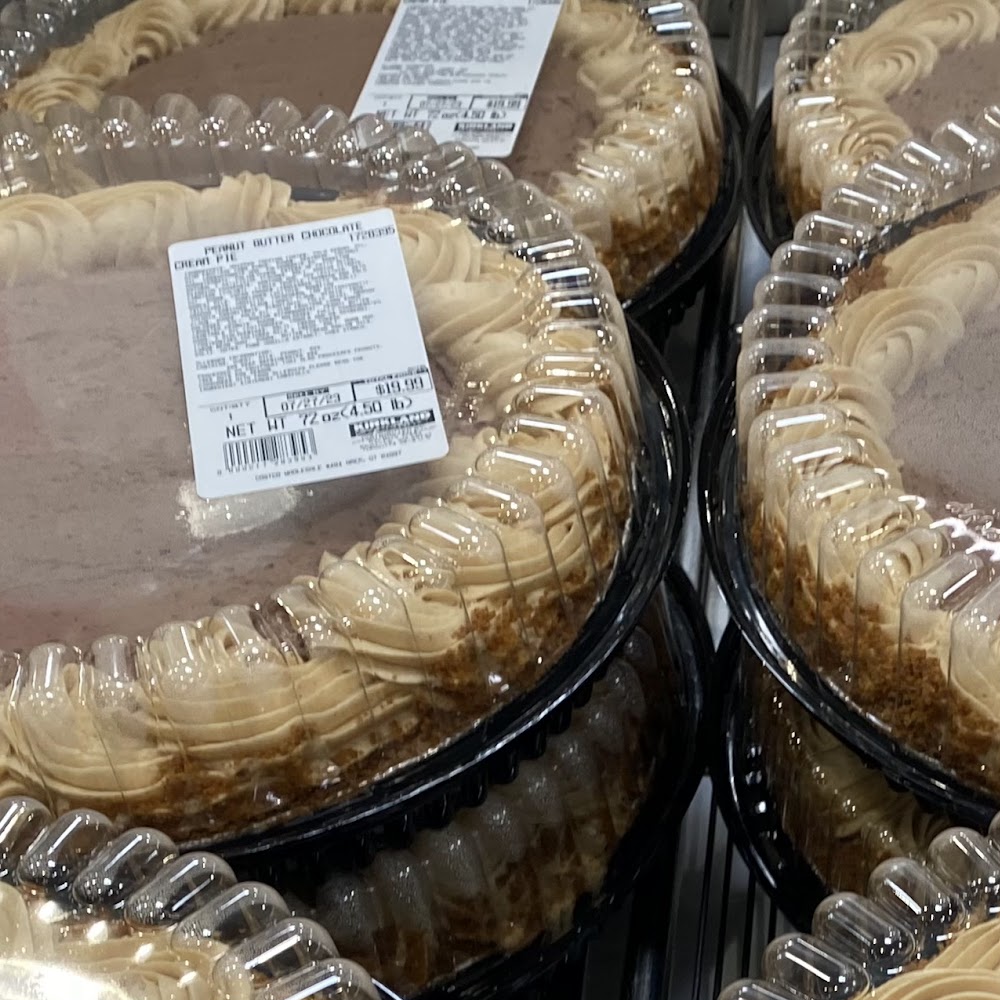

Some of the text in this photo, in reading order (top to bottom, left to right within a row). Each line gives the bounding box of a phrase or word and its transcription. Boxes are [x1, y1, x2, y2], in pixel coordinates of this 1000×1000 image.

[204, 240, 245, 255] PEANUT
[300, 220, 362, 239] CHOCOLATE
[174, 251, 237, 270] CREAM PIE
[374, 376, 424, 395] $19.99
[225, 421, 256, 438] NET
[266, 416, 286, 431] WT
